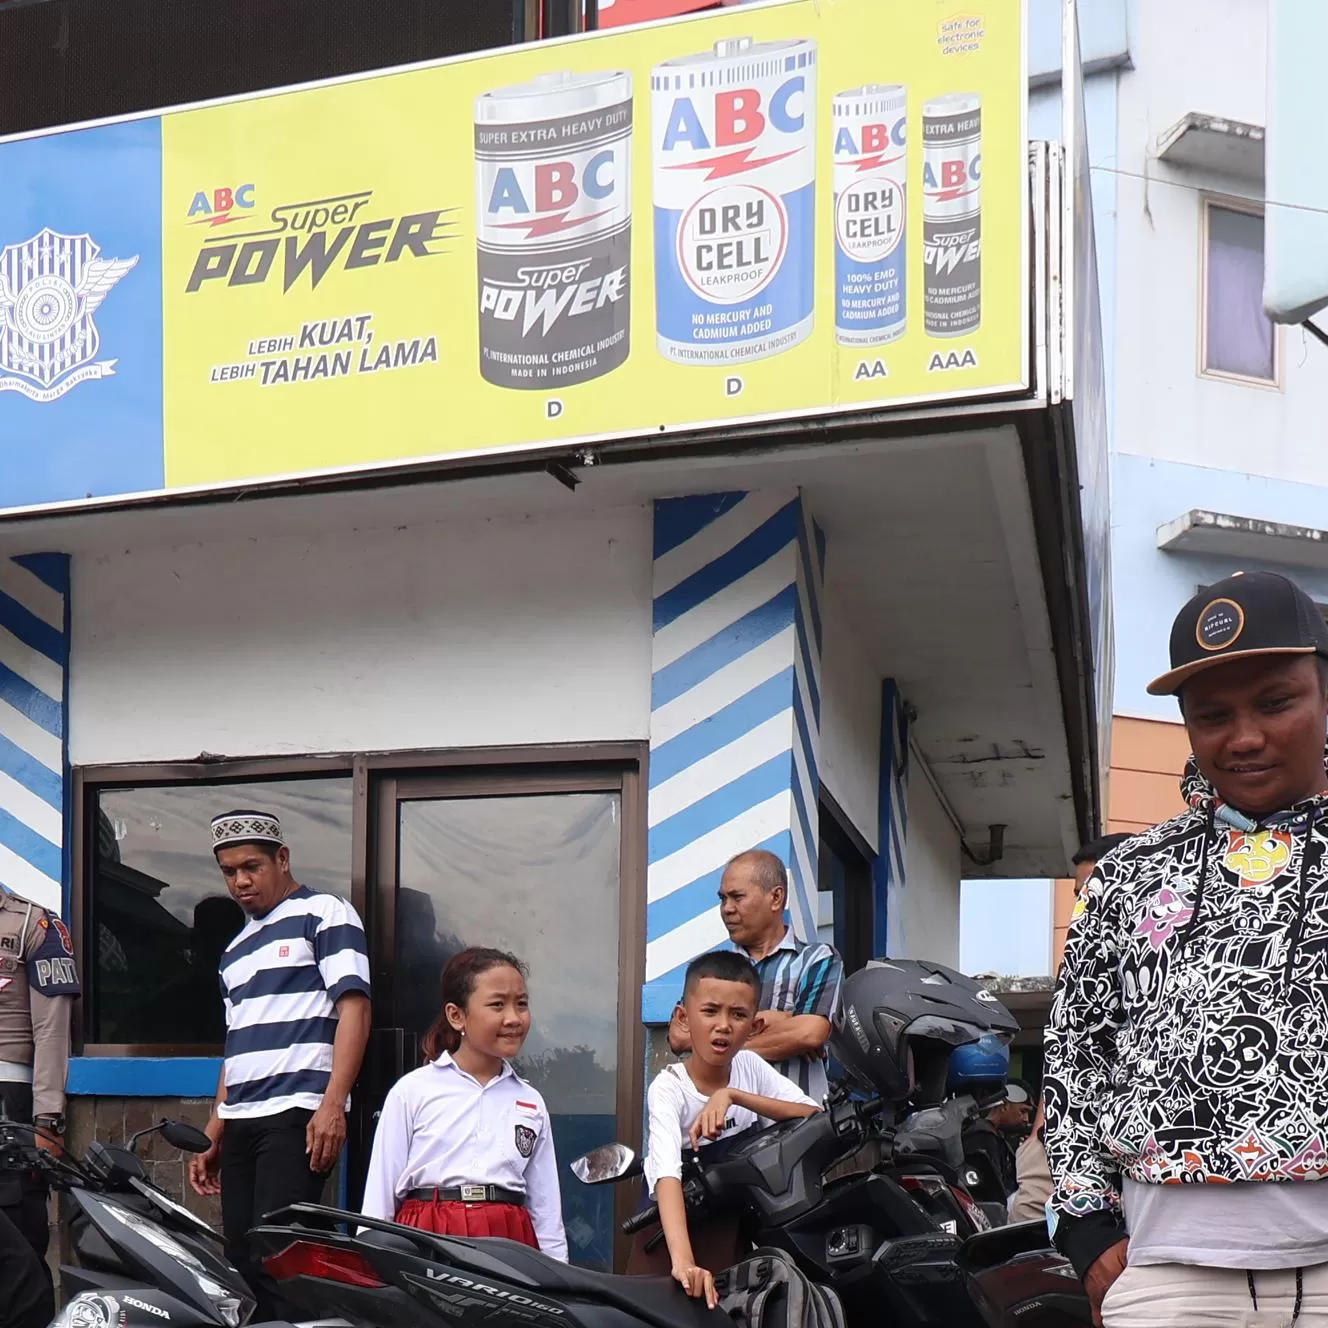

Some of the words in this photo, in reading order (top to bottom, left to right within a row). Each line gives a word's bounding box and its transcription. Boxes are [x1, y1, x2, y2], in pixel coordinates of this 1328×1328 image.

[662, 76, 805, 151] ABC
[479, 132, 508, 145] SUPER
[511, 128, 557, 144] EXTRA
[562, 117, 602, 137] HEAVY
[605, 110, 627, 126] DUTY
[488, 150, 615, 214] ABC
[187, 184, 255, 216] ABC
[272, 191, 372, 233] Super
[847, 188, 893, 213] DRY
[699, 199, 764, 235] DRY
[846, 214, 896, 239] CELL
[849, 236, 893, 249] LEAKPROOF
[932, 228, 976, 247] Super
[185, 206, 460, 295] POWER
[696, 237, 769, 271] CELL
[517, 257, 592, 289] Super
[701, 269, 763, 286] LEAKPROOF
[847, 273, 872, 283] 100%
[875, 268, 895, 280] EMD
[842, 284, 872, 294] HEAVY
[875, 278, 899, 291] DUTY
[939, 282, 976, 296] MERCURY
[481, 265, 627, 338] POWER
[692, 313, 704, 324] NO
[707, 309, 750, 324] MERCURY
[754, 304, 772, 318] AND
[843, 308, 876, 319] CADMIUM
[878, 304, 899, 317] ADDED
[852, 296, 885, 308] MERCURY
[248, 337, 294, 355] LEBIH
[299, 315, 373, 348] KUAT,
[693, 325, 738, 339] CADMIUM
[740, 319, 771, 335] ADDED
[490, 349, 549, 365] INTERNATIONAL
[552, 345, 595, 362] CHEMICAL
[597, 329, 625, 352] INDUSTRY
[678, 348, 729, 360] INTERNATIONAL
[731, 343, 767, 358] CHEMICAL
[769, 332, 797, 350] INDUSTRY
[211, 364, 255, 381] LEBIH
[261, 351, 351, 384] TAHAN
[359, 338, 437, 372] LAMA
[511, 368, 533, 377] MADE
[537, 368, 547, 377] IN
[552, 358, 597, 376] INDONESIA
[856, 361, 886, 379] AA
[929, 350, 976, 371] AAA
[727, 378, 742, 395] D
[547, 401, 562, 418] D
[35, 957, 79, 987] PAT
[427, 1268, 533, 1305] VARIO
[530, 1302, 565, 1315] 160
[123, 1295, 171, 1320] HONDA
[1013, 1301, 1042, 1316] HONDA
